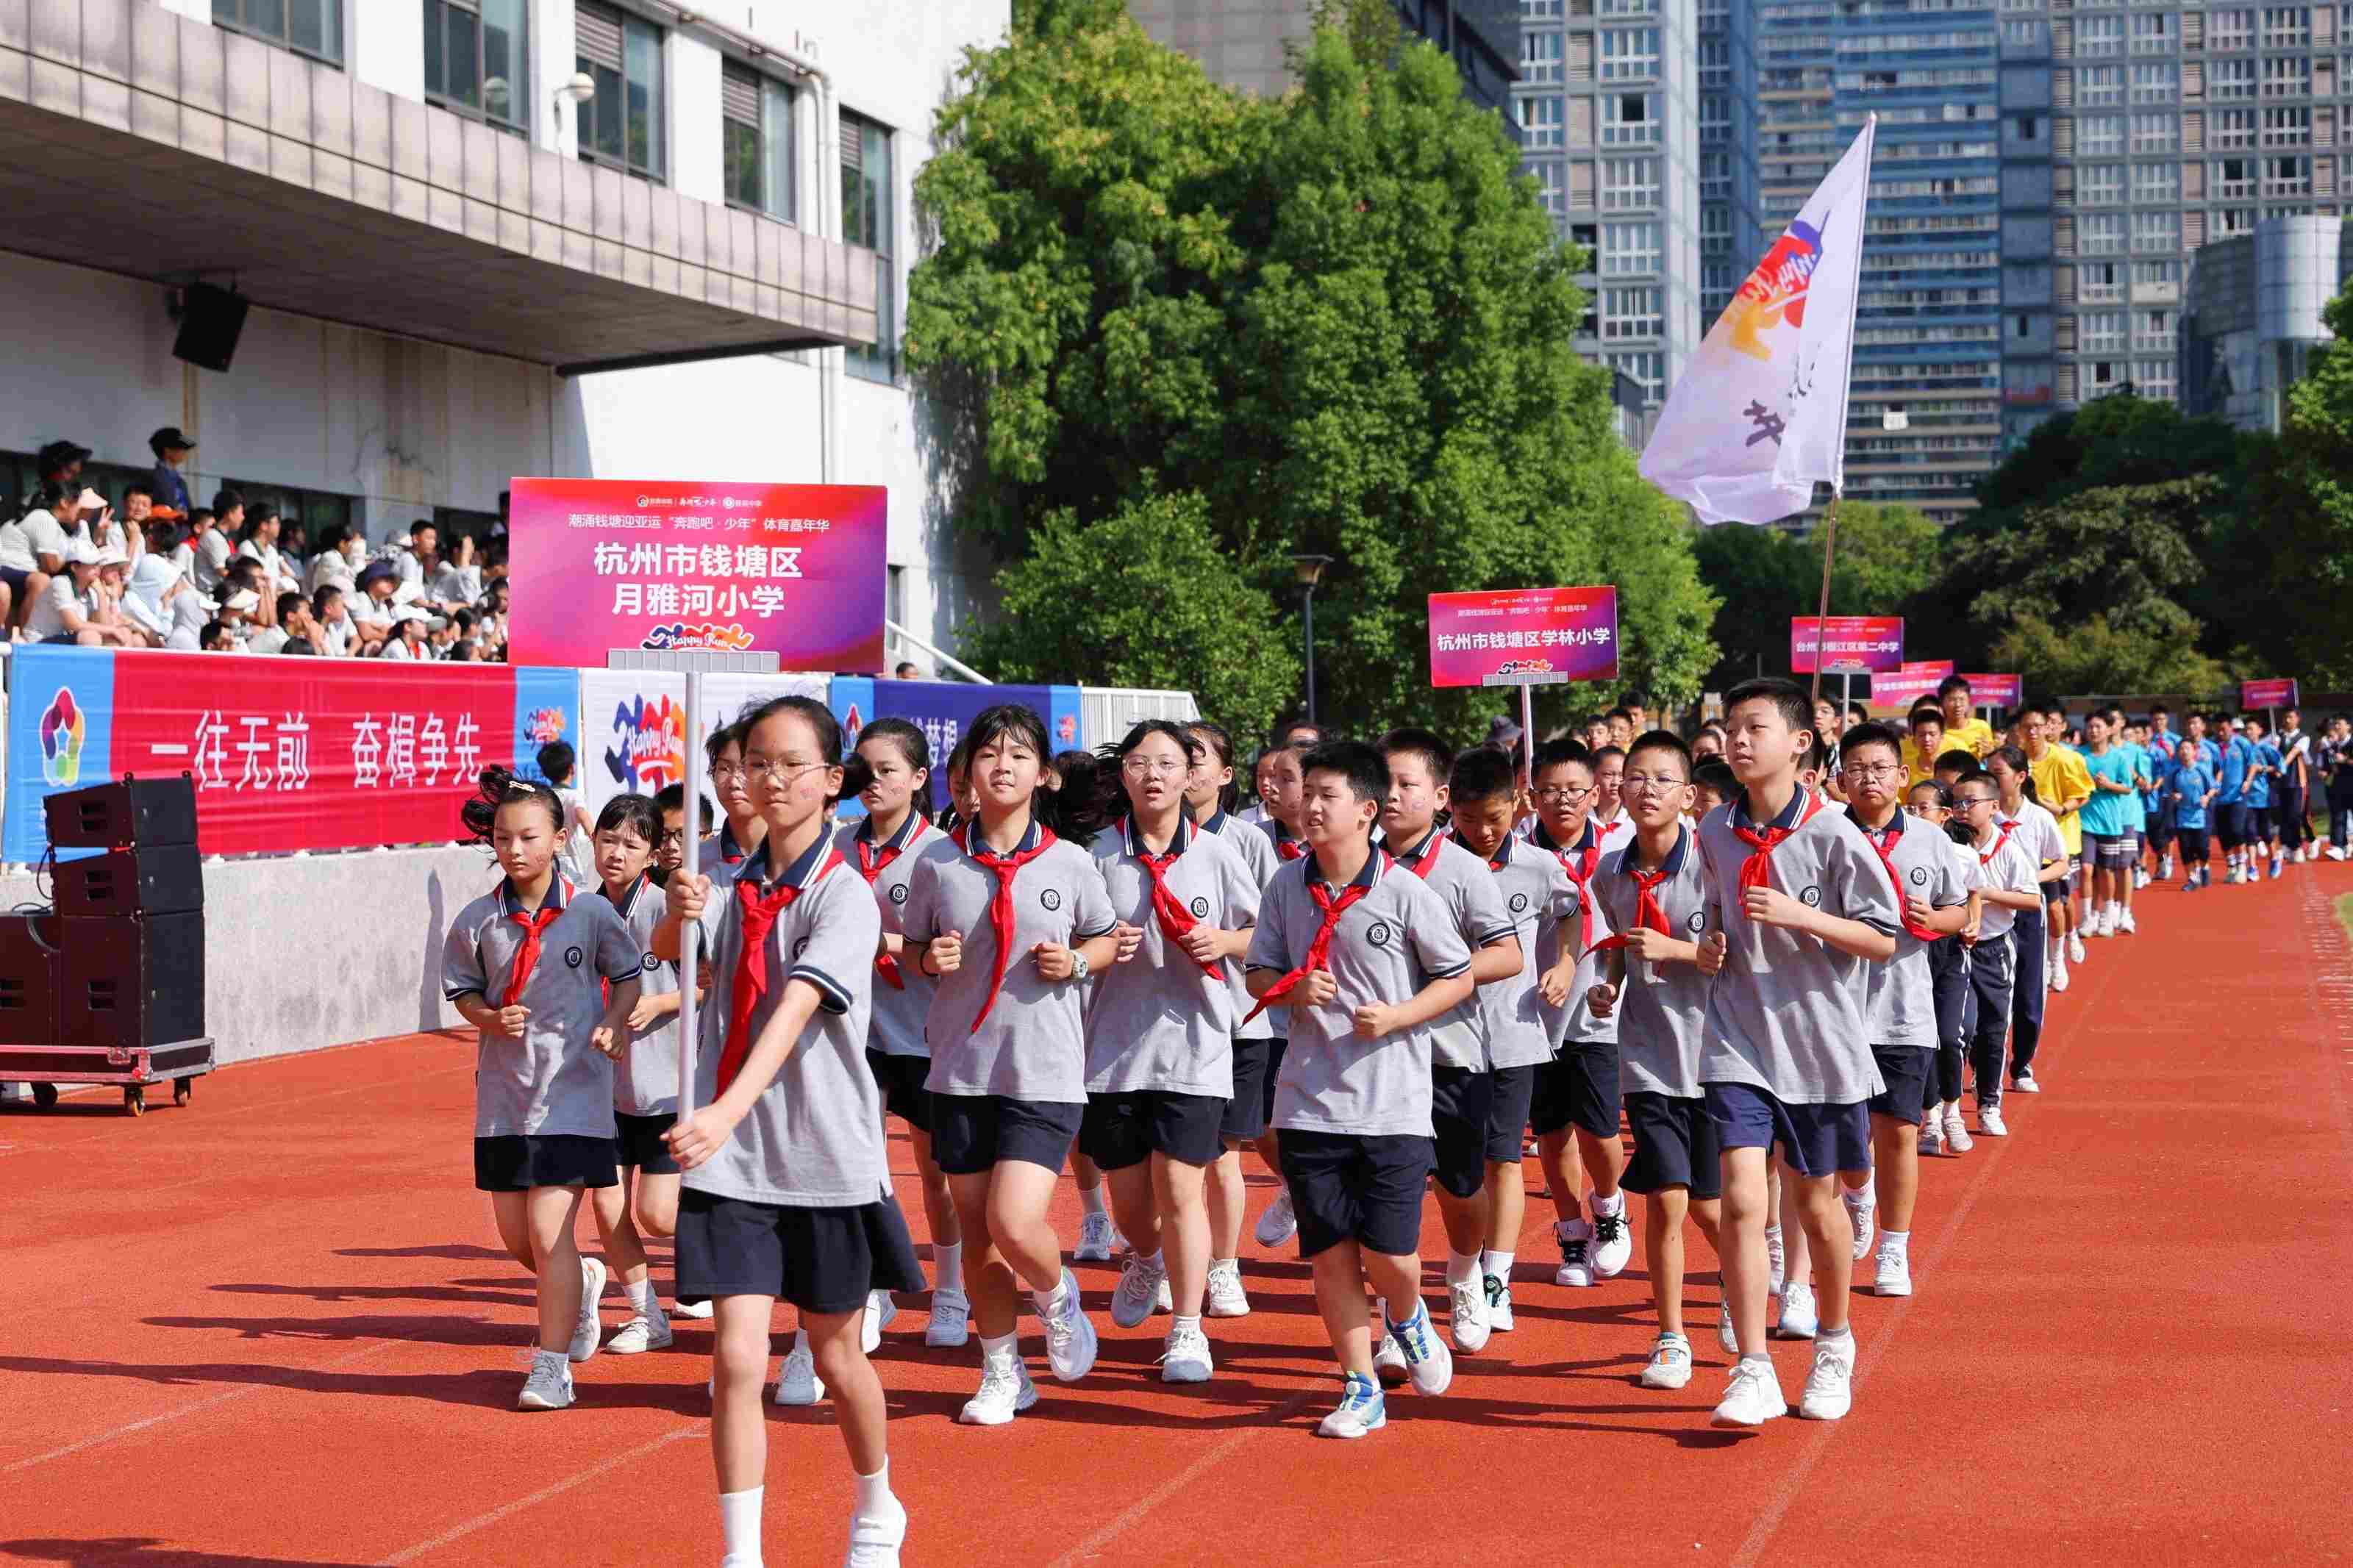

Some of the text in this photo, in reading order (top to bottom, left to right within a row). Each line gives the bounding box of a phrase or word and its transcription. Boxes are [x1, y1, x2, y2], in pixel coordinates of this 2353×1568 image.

[568, 513, 662, 529] 潮涌钱塘迎亚运
[764, 518, 830, 534] 体育嘉年华
[593, 541, 802, 579] 杭州市钱塘区
[611, 583, 785, 618] 月雅河小学
[665, 632, 729, 649] Happy Run
[1437, 627, 1610, 651] 杭州市钱塘区学林小学
[151, 710, 484, 792] 一往无前 奋楫争先
[626, 724, 661, 766] Happy
